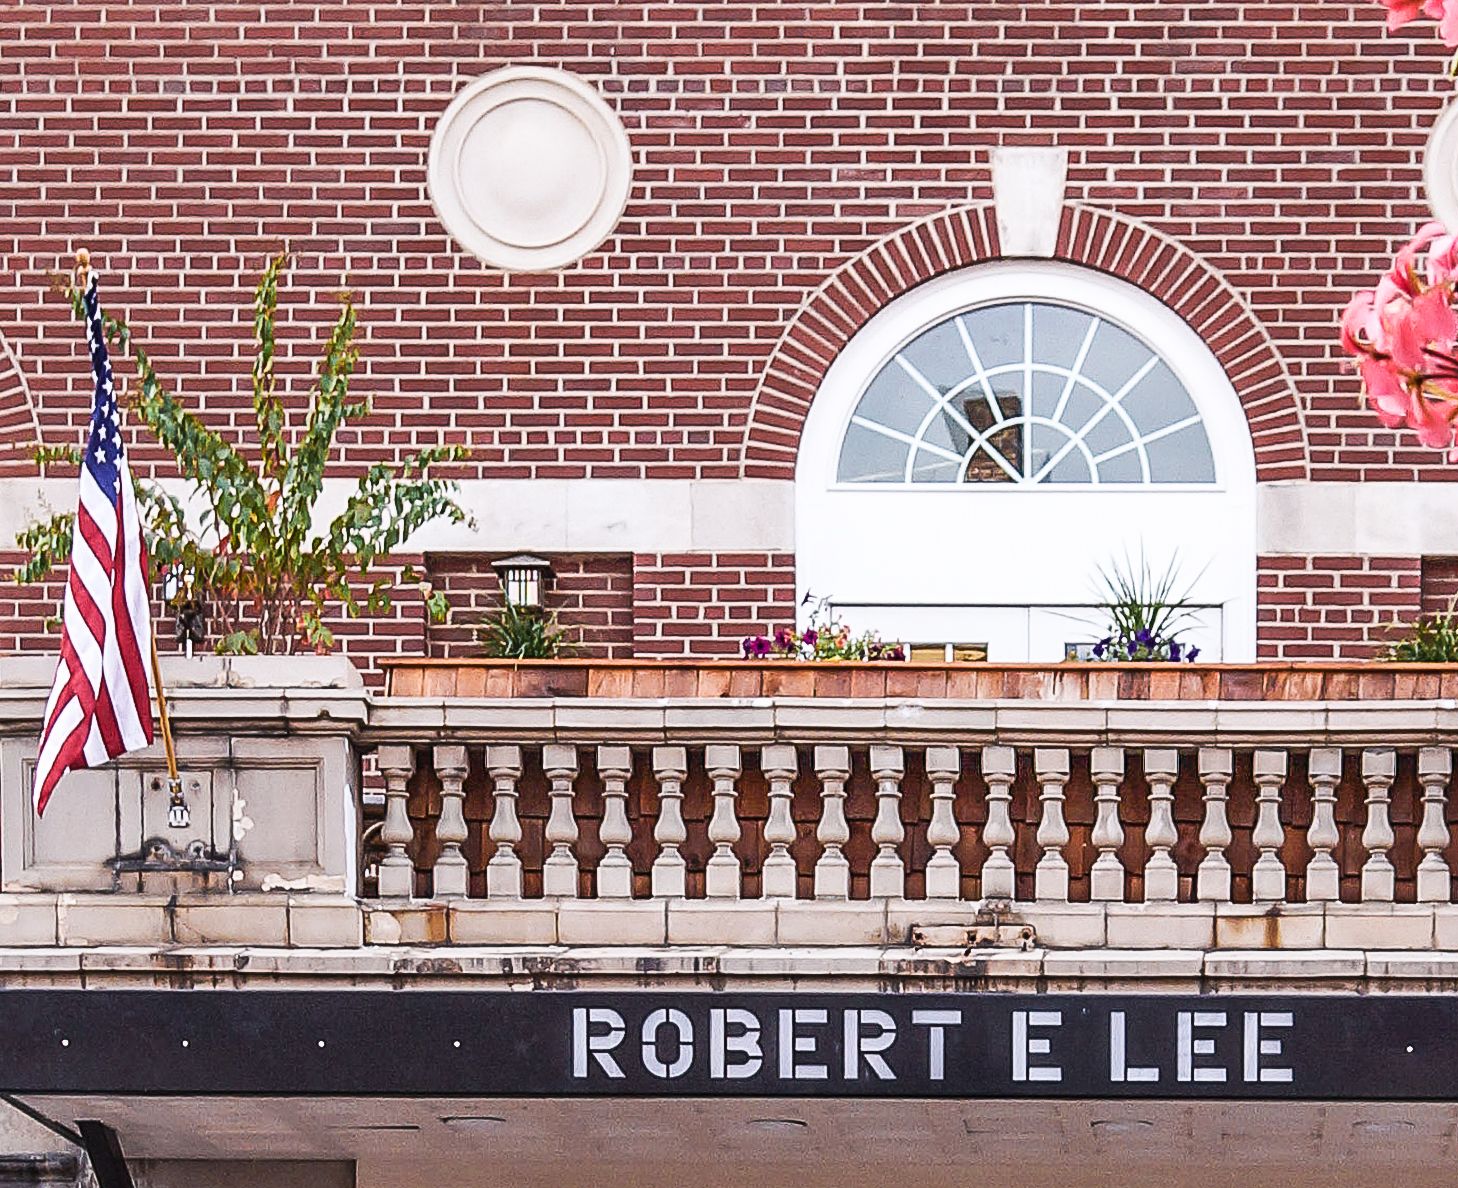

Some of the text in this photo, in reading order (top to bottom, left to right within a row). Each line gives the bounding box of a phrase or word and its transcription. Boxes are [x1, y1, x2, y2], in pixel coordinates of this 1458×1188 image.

[573, 1007, 1294, 1082] ROBERT E LEE
